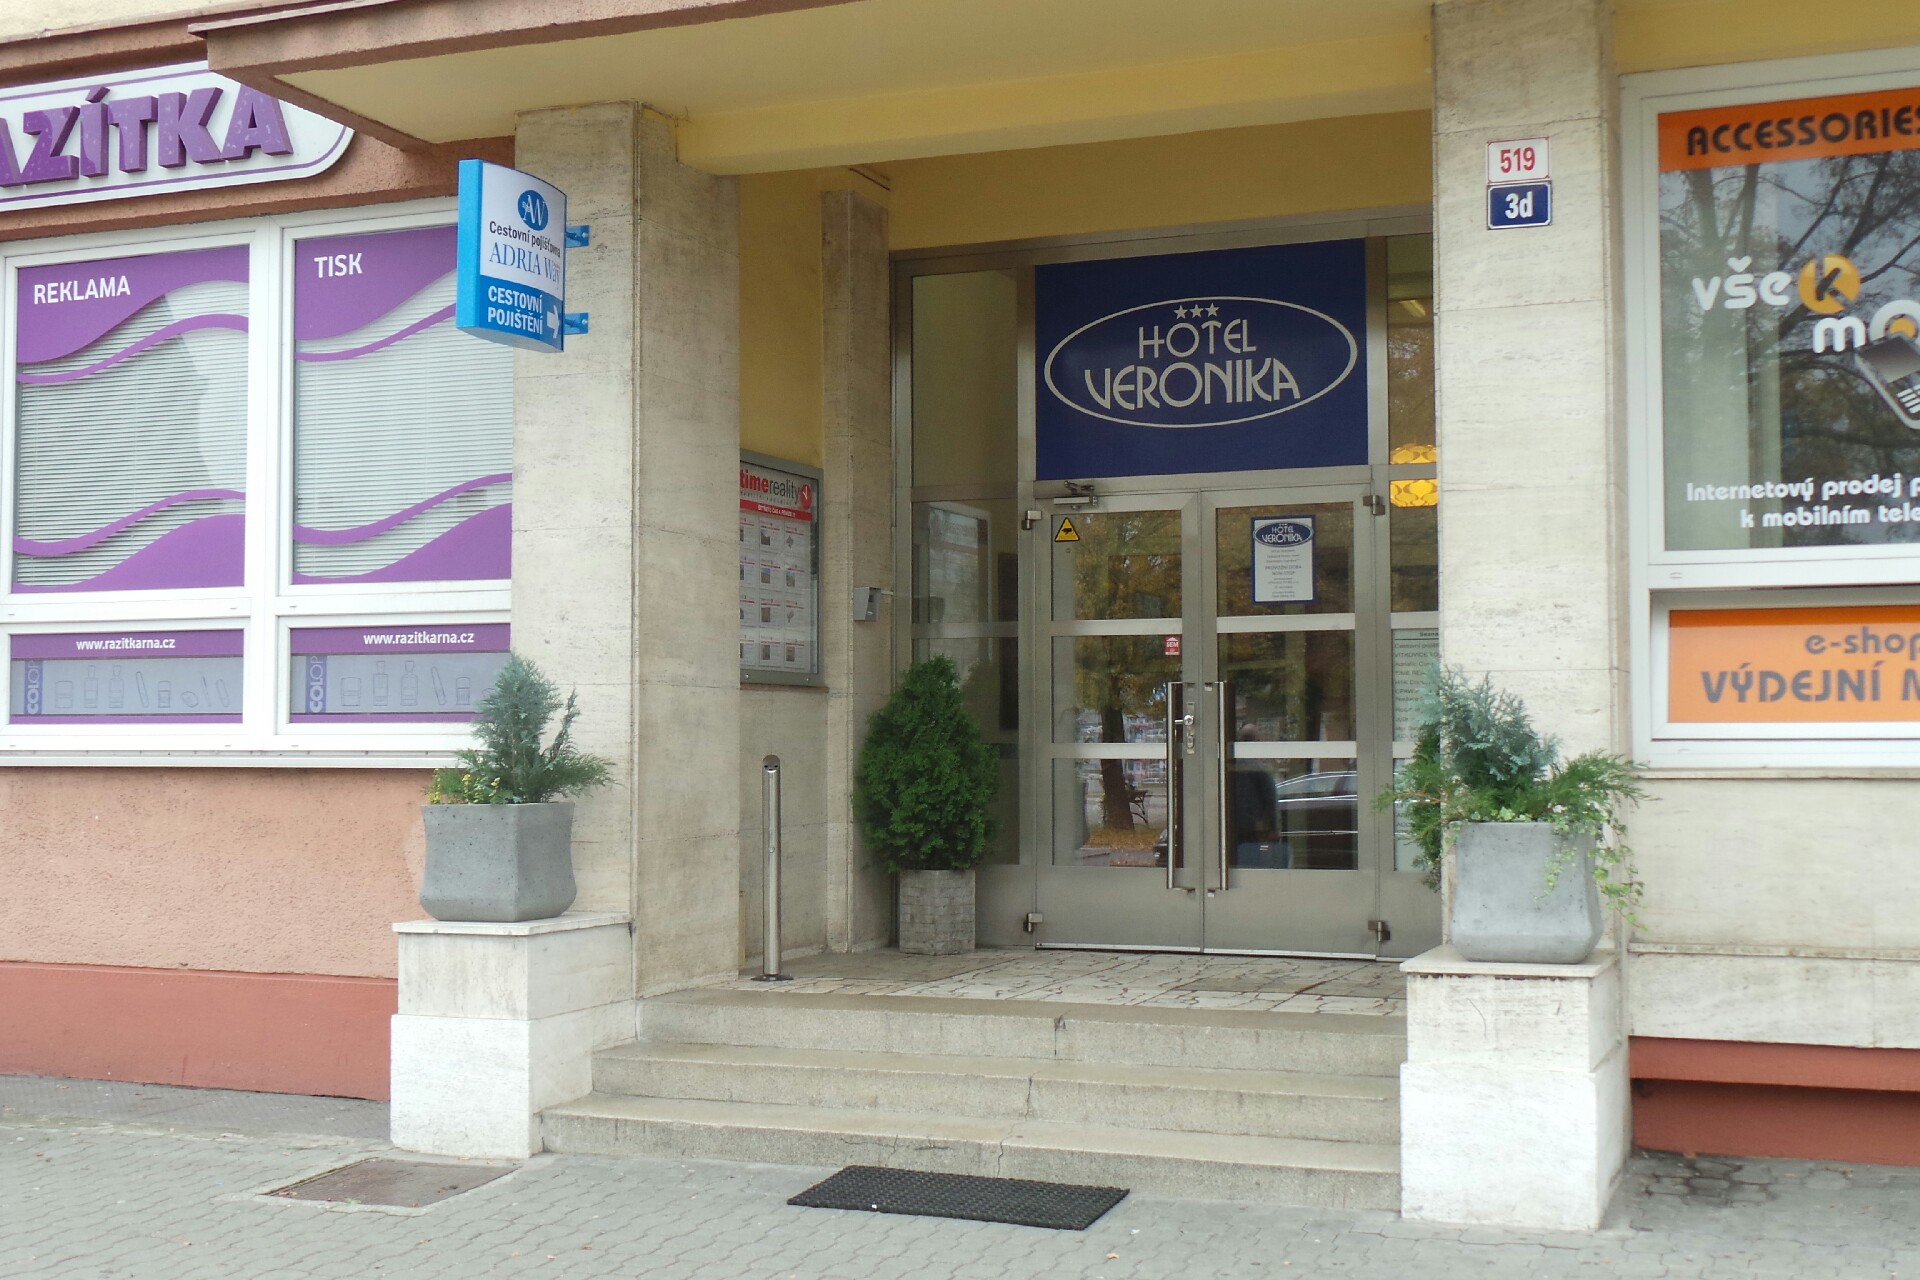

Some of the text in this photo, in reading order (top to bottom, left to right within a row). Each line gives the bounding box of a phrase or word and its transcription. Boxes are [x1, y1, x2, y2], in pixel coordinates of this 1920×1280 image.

[1500, 147, 1536, 173] 519
[1504, 191, 1533, 219] 3d
[489, 220, 530, 243] Cestovní
[314, 252, 363, 279] TISK
[488, 242, 541, 275] ADRIA
[33, 275, 131, 305] REKLAMA
[1692, 255, 1792, 311] vše
[488, 285, 543, 314] CESTOVNÍ
[487, 307, 543, 335] POJIŠTĚNÍ
[1138, 318, 1257, 359] HOTEL
[1084, 357, 1301, 411] VERONIKA
[1686, 477, 1814, 502] Internetový
[1822, 472, 1902, 501] prodej
[1271, 525, 1295, 534] HOTEL
[1740, 508, 1754, 528] k
[1762, 504, 1870, 527] mobilním
[1261, 532, 1303, 543] VERONIKA
[76, 636, 176, 651] www.razitkarna.cz
[363, 630, 475, 645] www.razitkarna.cz
[310, 656, 324, 713] COLOP
[1701, 660, 1885, 704] VÝDEJNÍ
